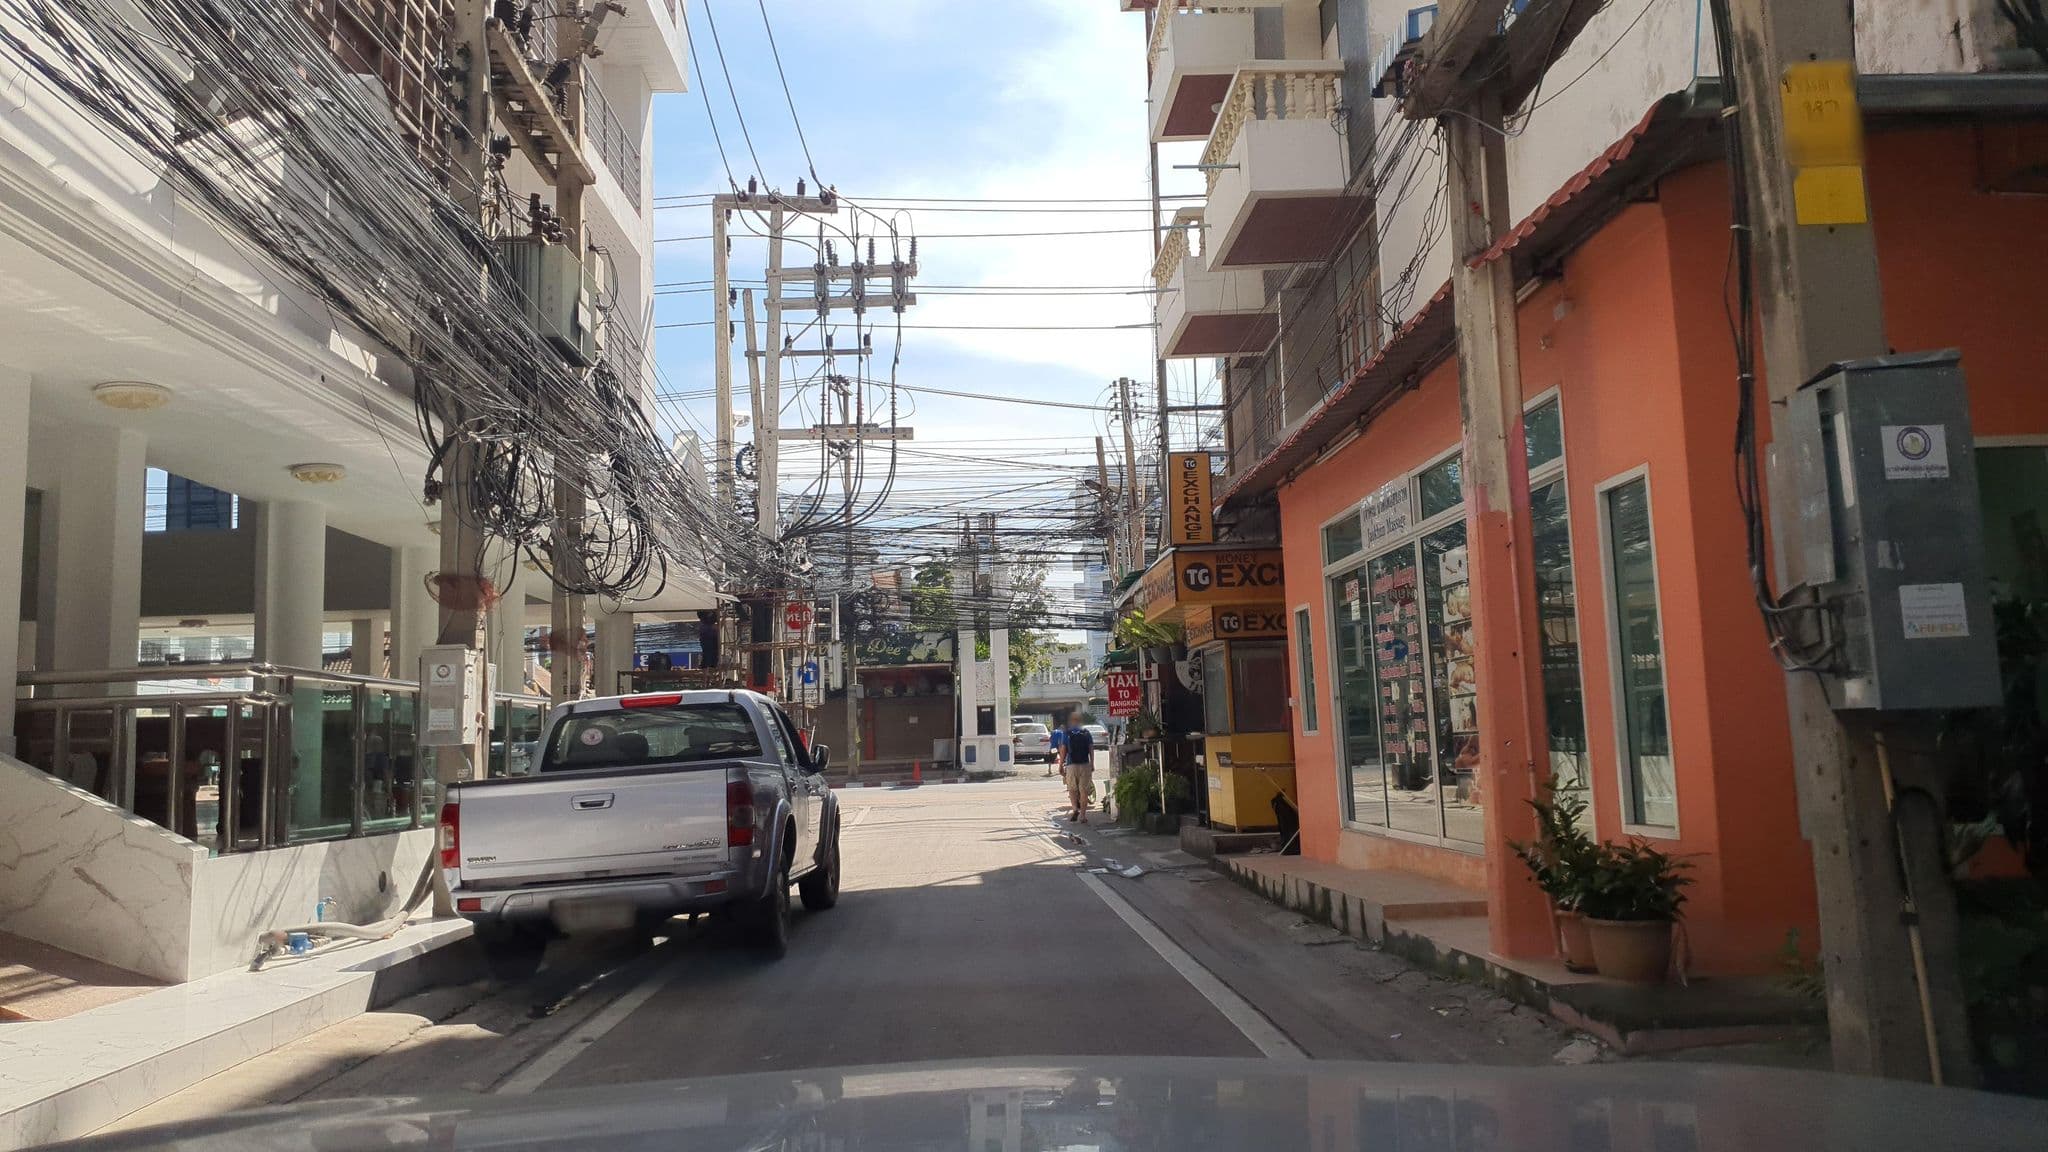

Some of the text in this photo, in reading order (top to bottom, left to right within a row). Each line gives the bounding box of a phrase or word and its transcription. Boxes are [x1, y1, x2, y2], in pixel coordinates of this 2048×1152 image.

[1184, 460, 1196, 468] TG
[1183, 471, 1202, 540] EXCHANGE
[1216, 552, 1257, 563] MONEY
[1186, 568, 1211, 586] TG
[1221, 616, 1238, 630] TG
[1108, 674, 1139, 688] TAXI
[1118, 690, 1130, 698] TO
